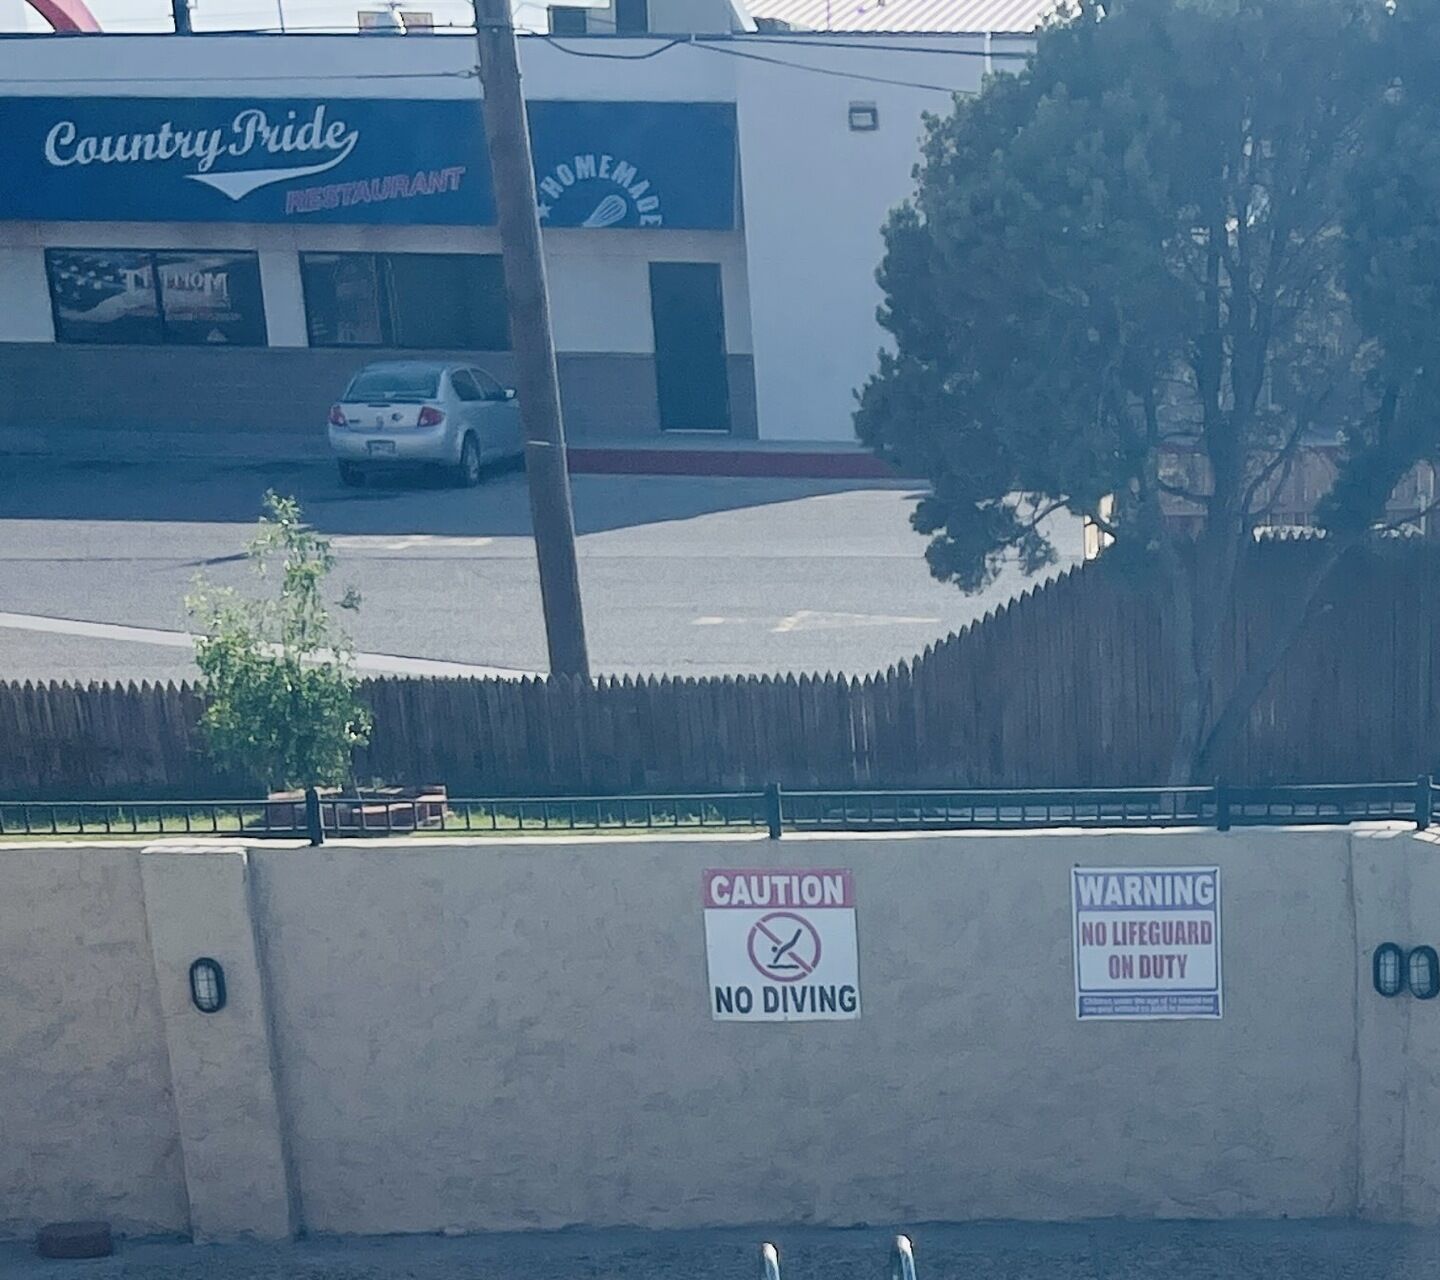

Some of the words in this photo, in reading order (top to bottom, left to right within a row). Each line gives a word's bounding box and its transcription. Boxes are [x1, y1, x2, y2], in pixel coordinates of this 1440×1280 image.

[45, 120, 226, 172] Country
[229, 104, 345, 156] Pride
[285, 166, 466, 215] RESTAURANT
[540, 153, 663, 227] HOMEMADE
[710, 875, 844, 906] CAUTION
[1077, 874, 1215, 906] WARNING
[1081, 921, 1108, 947] NO
[1112, 920, 1213, 947] LIFEGUARD
[1108, 954, 1134, 980] ON
[1139, 953, 1188, 979] DUTY
[715, 986, 754, 1014] NO
[763, 985, 857, 1014] DIVING
